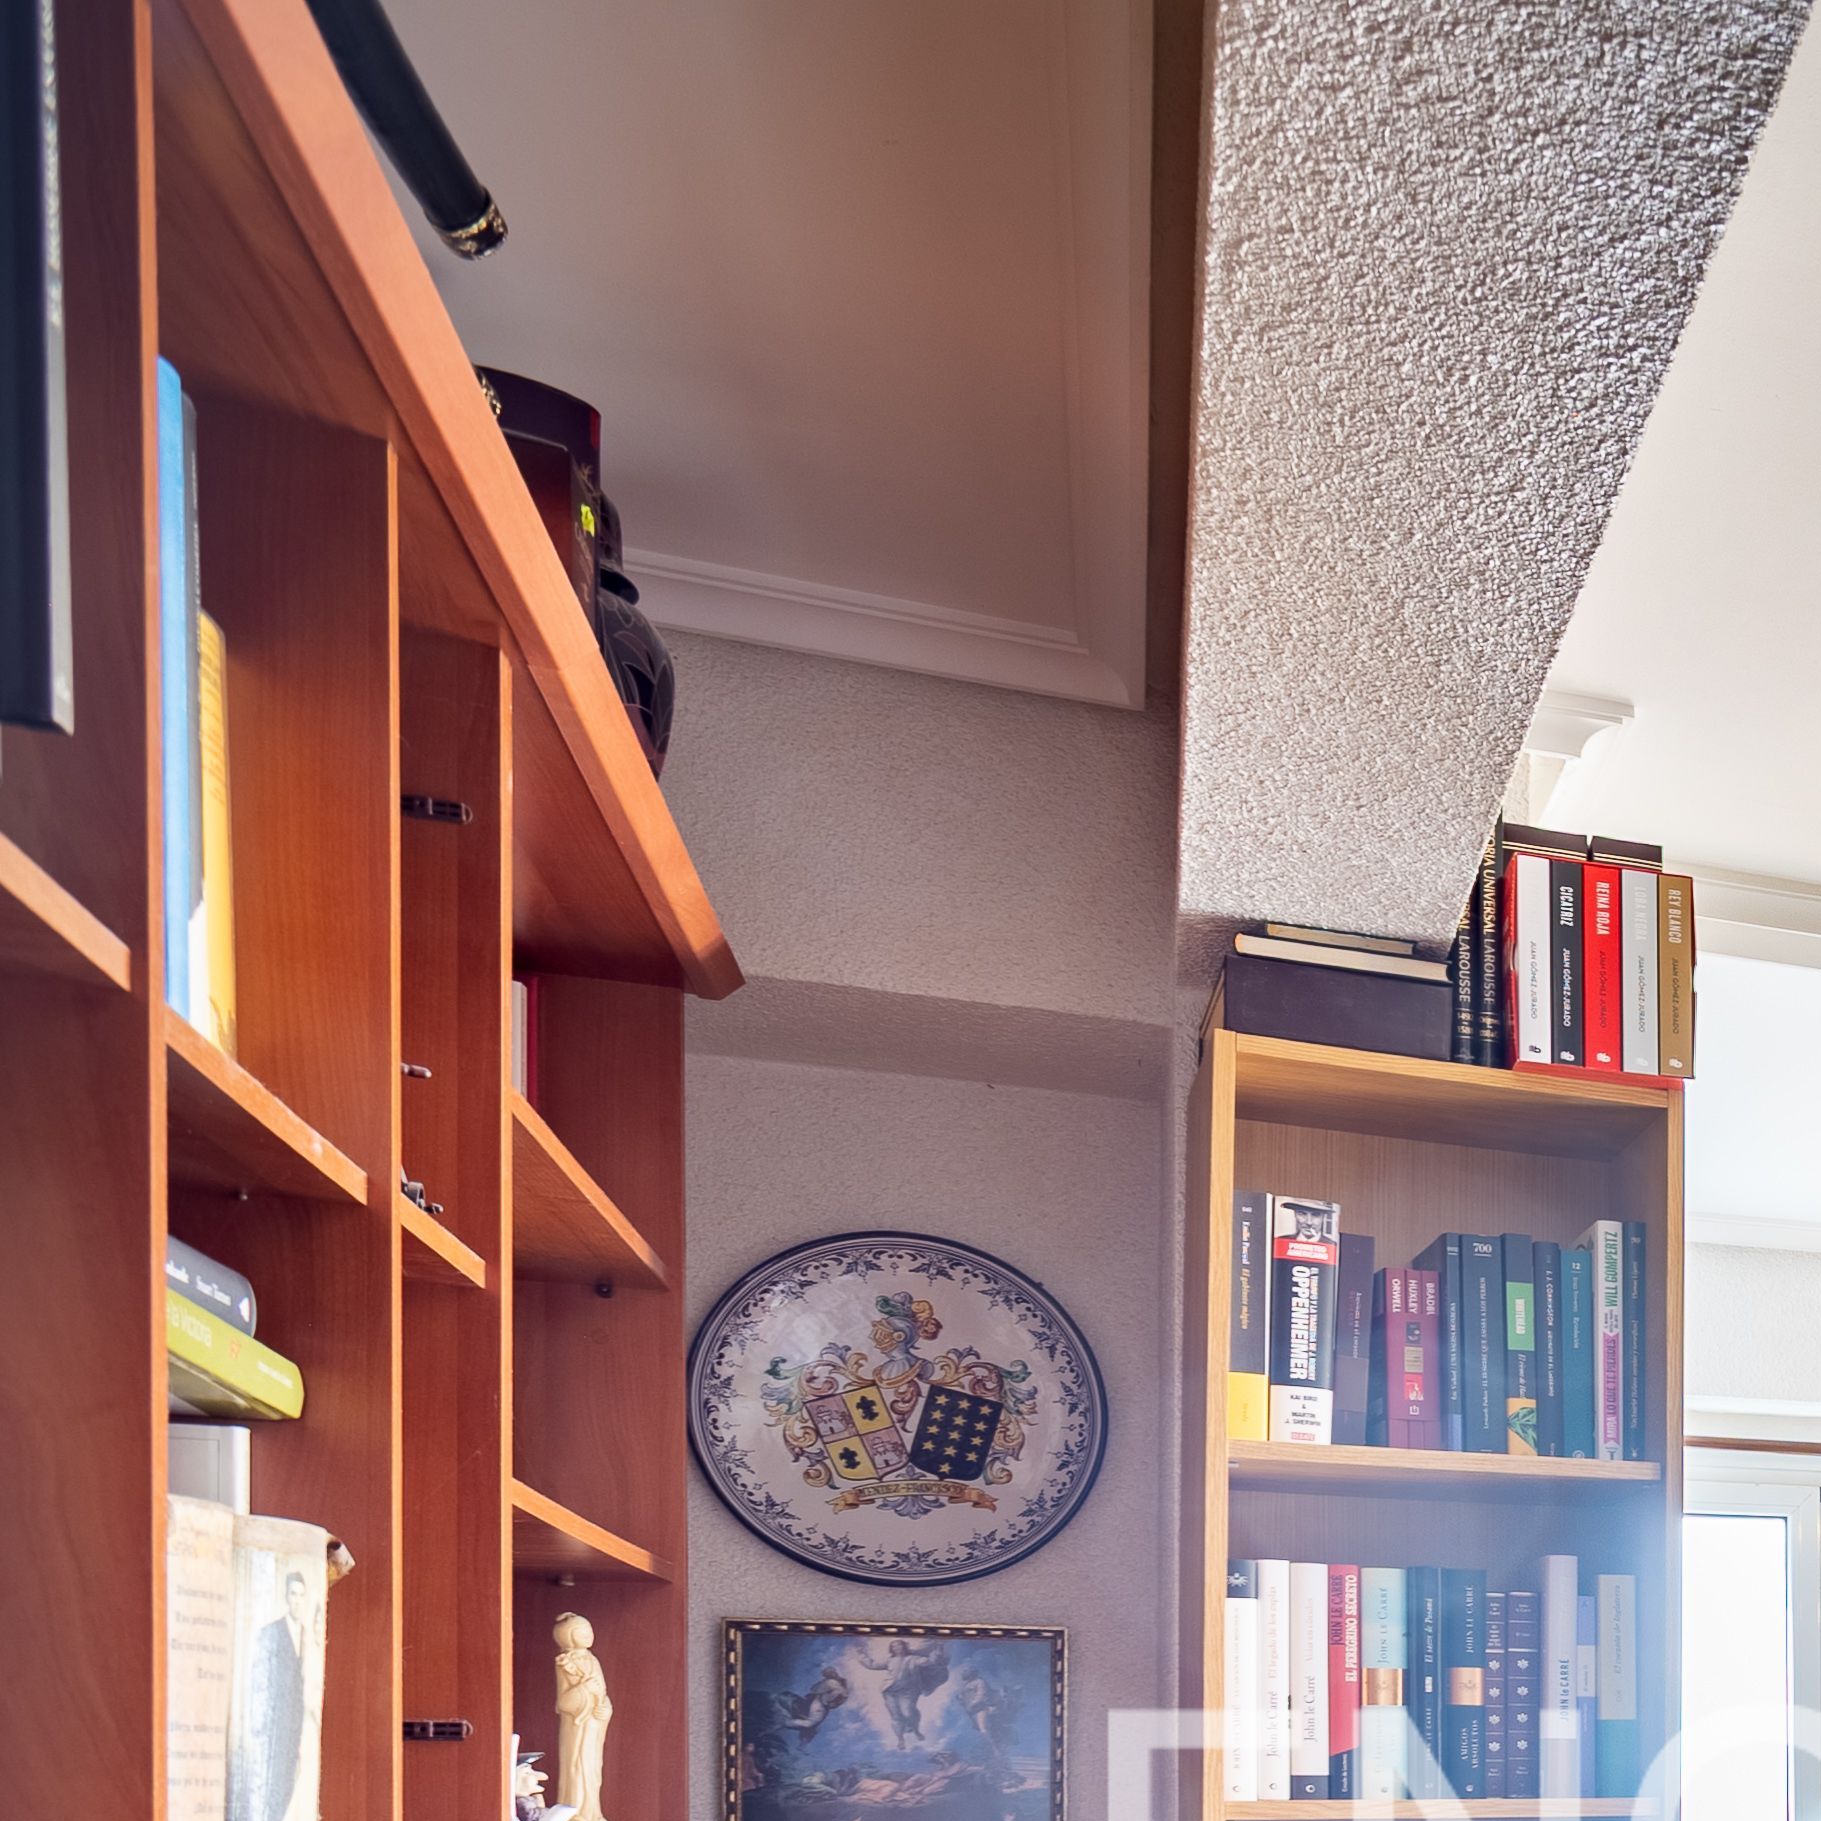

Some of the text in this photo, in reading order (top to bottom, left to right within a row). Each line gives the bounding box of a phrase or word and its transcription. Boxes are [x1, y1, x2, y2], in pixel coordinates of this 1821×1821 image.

[1483, 870, 1497, 1005] UNIVERSAL LAROUSSE
[1559, 886, 1573, 926] CICATRIZ
[1596, 882, 1610, 935] REINA ROJA
[1668, 889, 1682, 944] REY BLANCO
[1458, 936, 1470, 1003] LAROUSSE
[1530, 961, 1538, 1019] GÓMEZ-JURADO
[1562, 948, 1572, 1027] JUAN GÓMEZ-JURADO
[1599, 951, 1608, 1028] JUAN GÓMEZ-JURADO
[1637, 955, 1646, 1033] JUAN GÓMEZ-JURADO
[1671, 957, 1680, 1034] JUAN GÓMEZ-JURADO
[1473, 1242, 1492, 1253] 700
[1605, 1231, 1617, 1307] WILL GOMPERTZ
[1290, 1266, 1310, 1380] OPPENHEIMER
[1391, 1278, 1401, 1312] ORWELL
[1408, 1280, 1418, 1313] HUXLEY
[1605, 1339, 1617, 1439] MIRA LO QUE TE PIERDES
[1329, 1575, 1345, 1645] JOHN LE CARRÉ
[1345, 1574, 1358, 1682] EL PEREGRINO SECRETO
[1464, 1585, 1474, 1653] JOHN LE CARRÉ
[1557, 1659, 1569, 1687] CARRÉ
[1265, 1691, 1279, 1757] John le Carré
[1303, 1675, 1318, 1742] John le Carré
[1560, 1698, 1569, 1721] JOHN
[1460, 1727, 1469, 1760] AMIGOS
[1471, 1719, 1480, 1769] ABSOLUTOS
